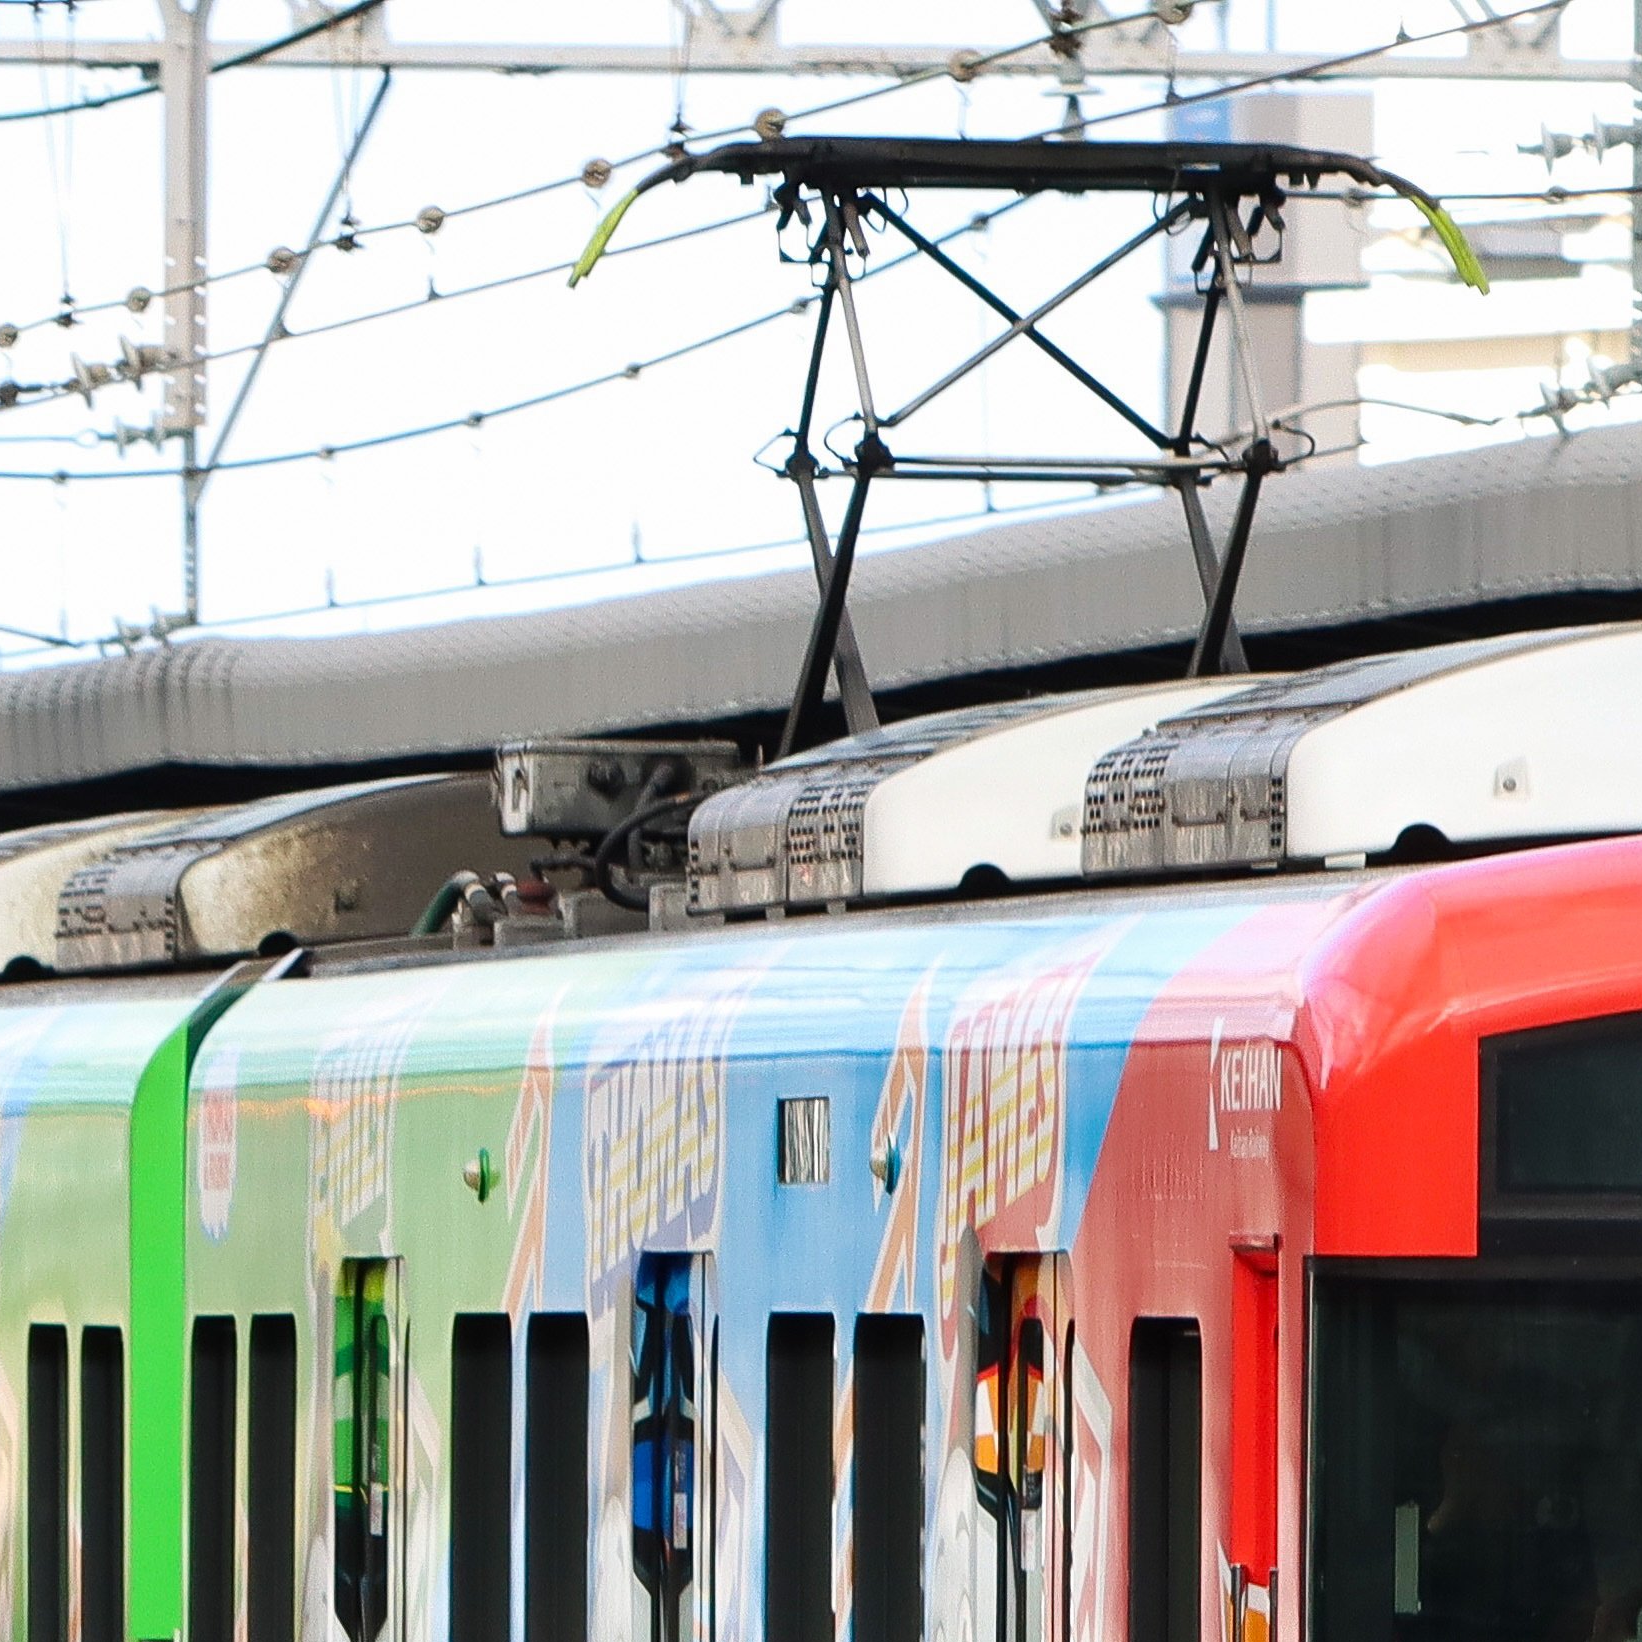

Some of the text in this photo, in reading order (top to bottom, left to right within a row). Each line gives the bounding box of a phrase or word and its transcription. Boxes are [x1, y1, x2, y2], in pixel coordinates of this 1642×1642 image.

[589, 1012, 723, 1282] THOMAS
[941, 978, 1069, 1320] JAMES
[1220, 1041, 1282, 1111] KEIHAN
